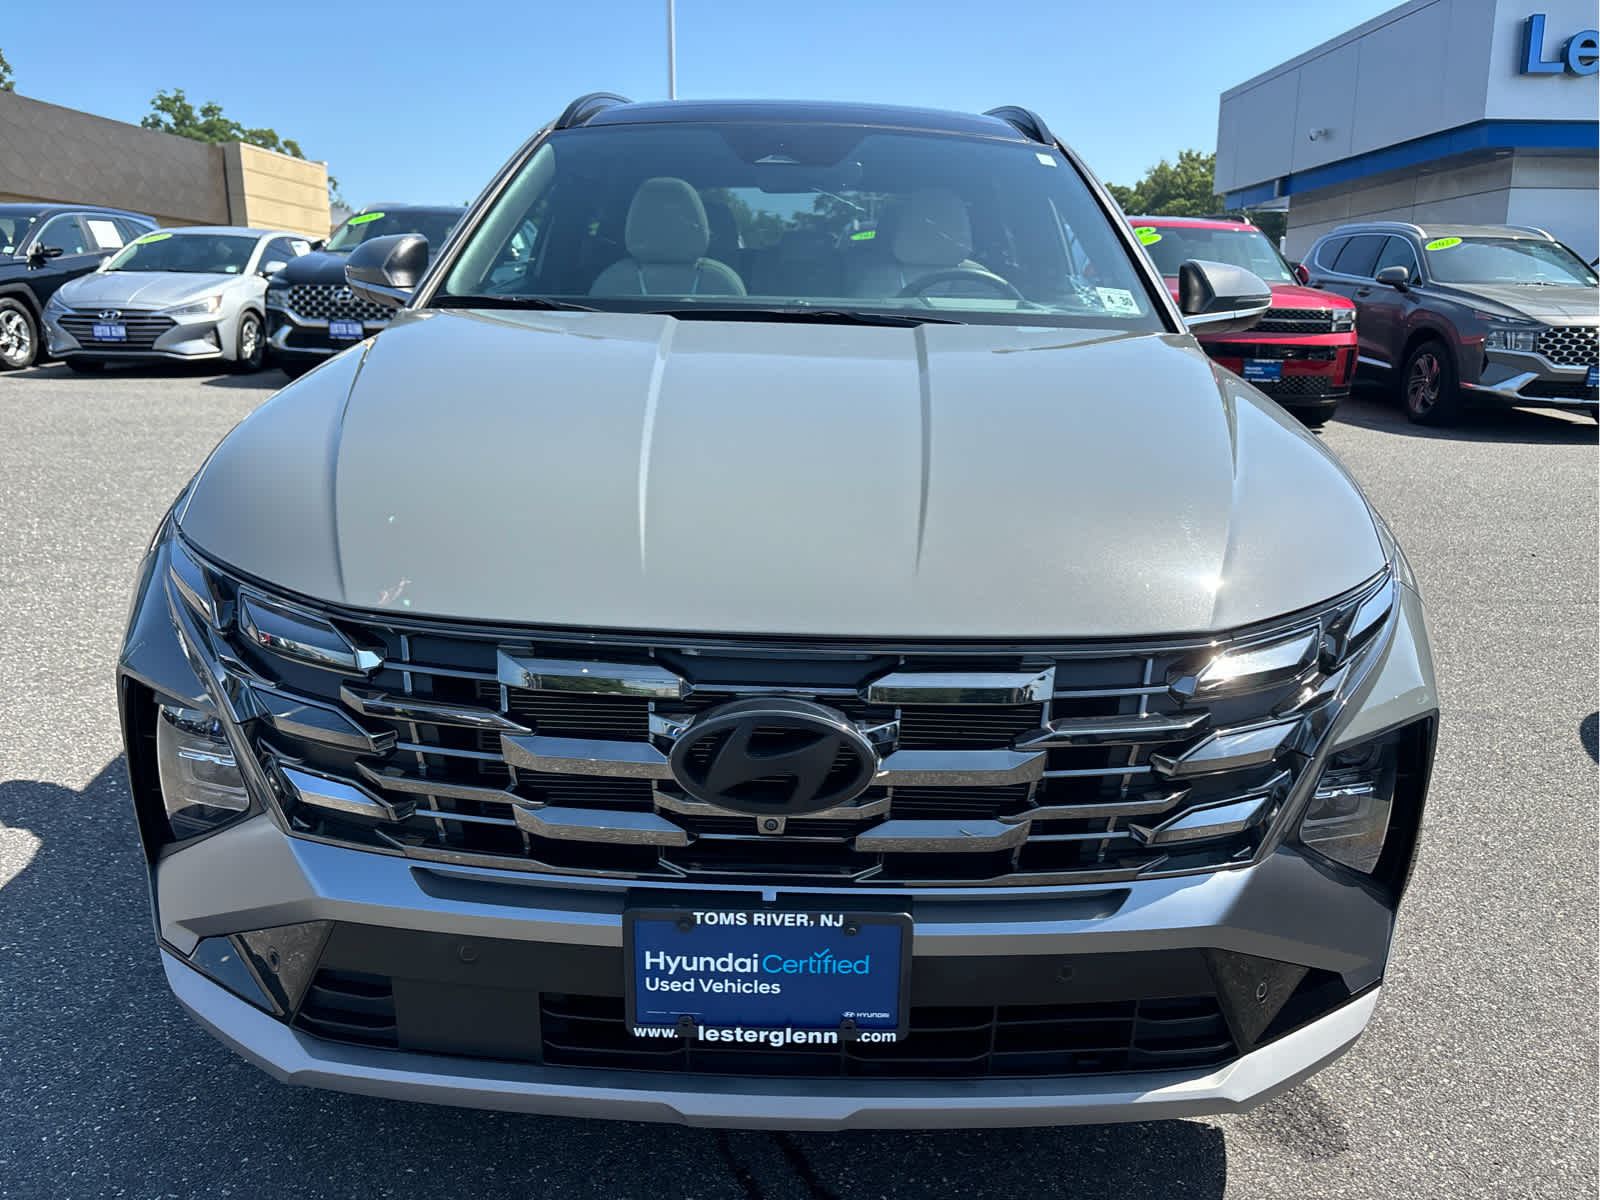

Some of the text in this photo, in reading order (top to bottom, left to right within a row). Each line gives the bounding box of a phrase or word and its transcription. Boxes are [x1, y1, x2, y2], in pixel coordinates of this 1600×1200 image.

[1522, 13, 1599, 76] Le
[692, 911, 845, 928] TOMS RIVER, NJ
[644, 948, 870, 975] Hyundai Certified
[645, 976, 781, 995] Used Vehicles
[698, 1025, 839, 1047] lesterglenn
